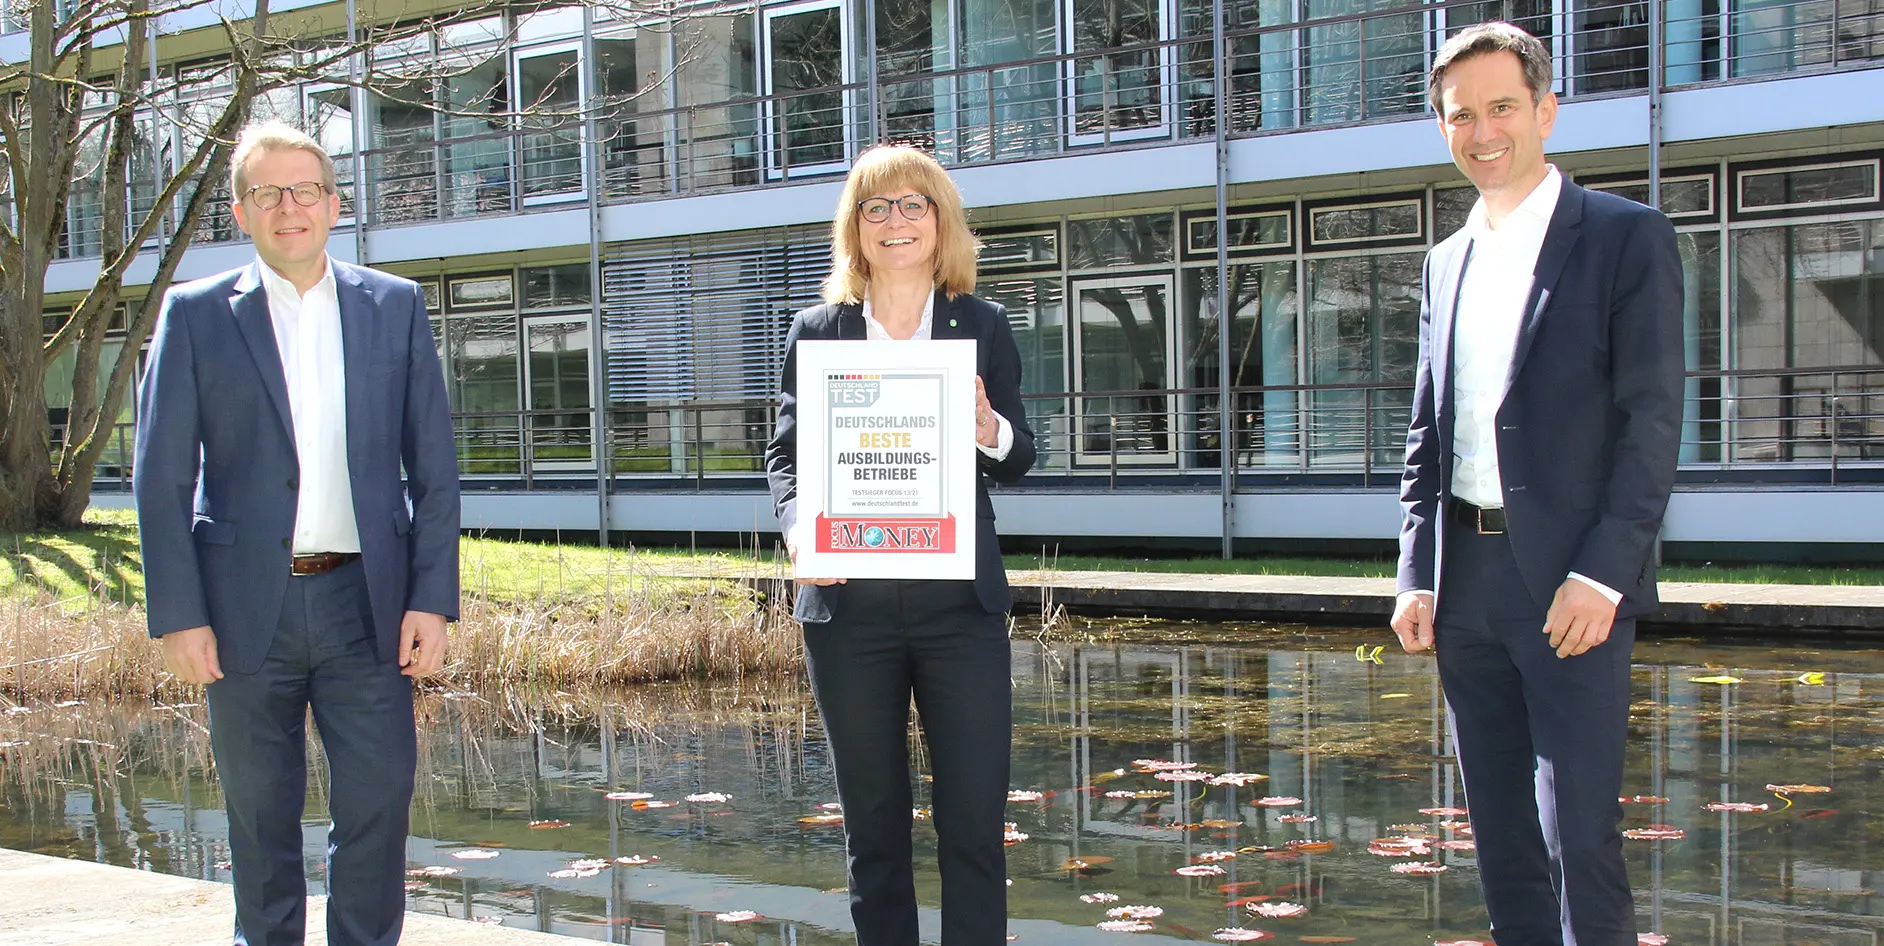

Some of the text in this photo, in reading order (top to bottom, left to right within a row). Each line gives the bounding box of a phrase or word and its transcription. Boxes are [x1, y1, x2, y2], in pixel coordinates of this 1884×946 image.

[830, 388, 879, 404] TEST
[835, 416, 936, 428] DEUTSCHLANDS
[859, 432, 912, 448] BESTE
[837, 452, 937, 465] AUSBILDUNGS-
[853, 468, 917, 480] BETRIEBE
[830, 521, 839, 549] FOCUS
[840, 523, 939, 548] MONEY
